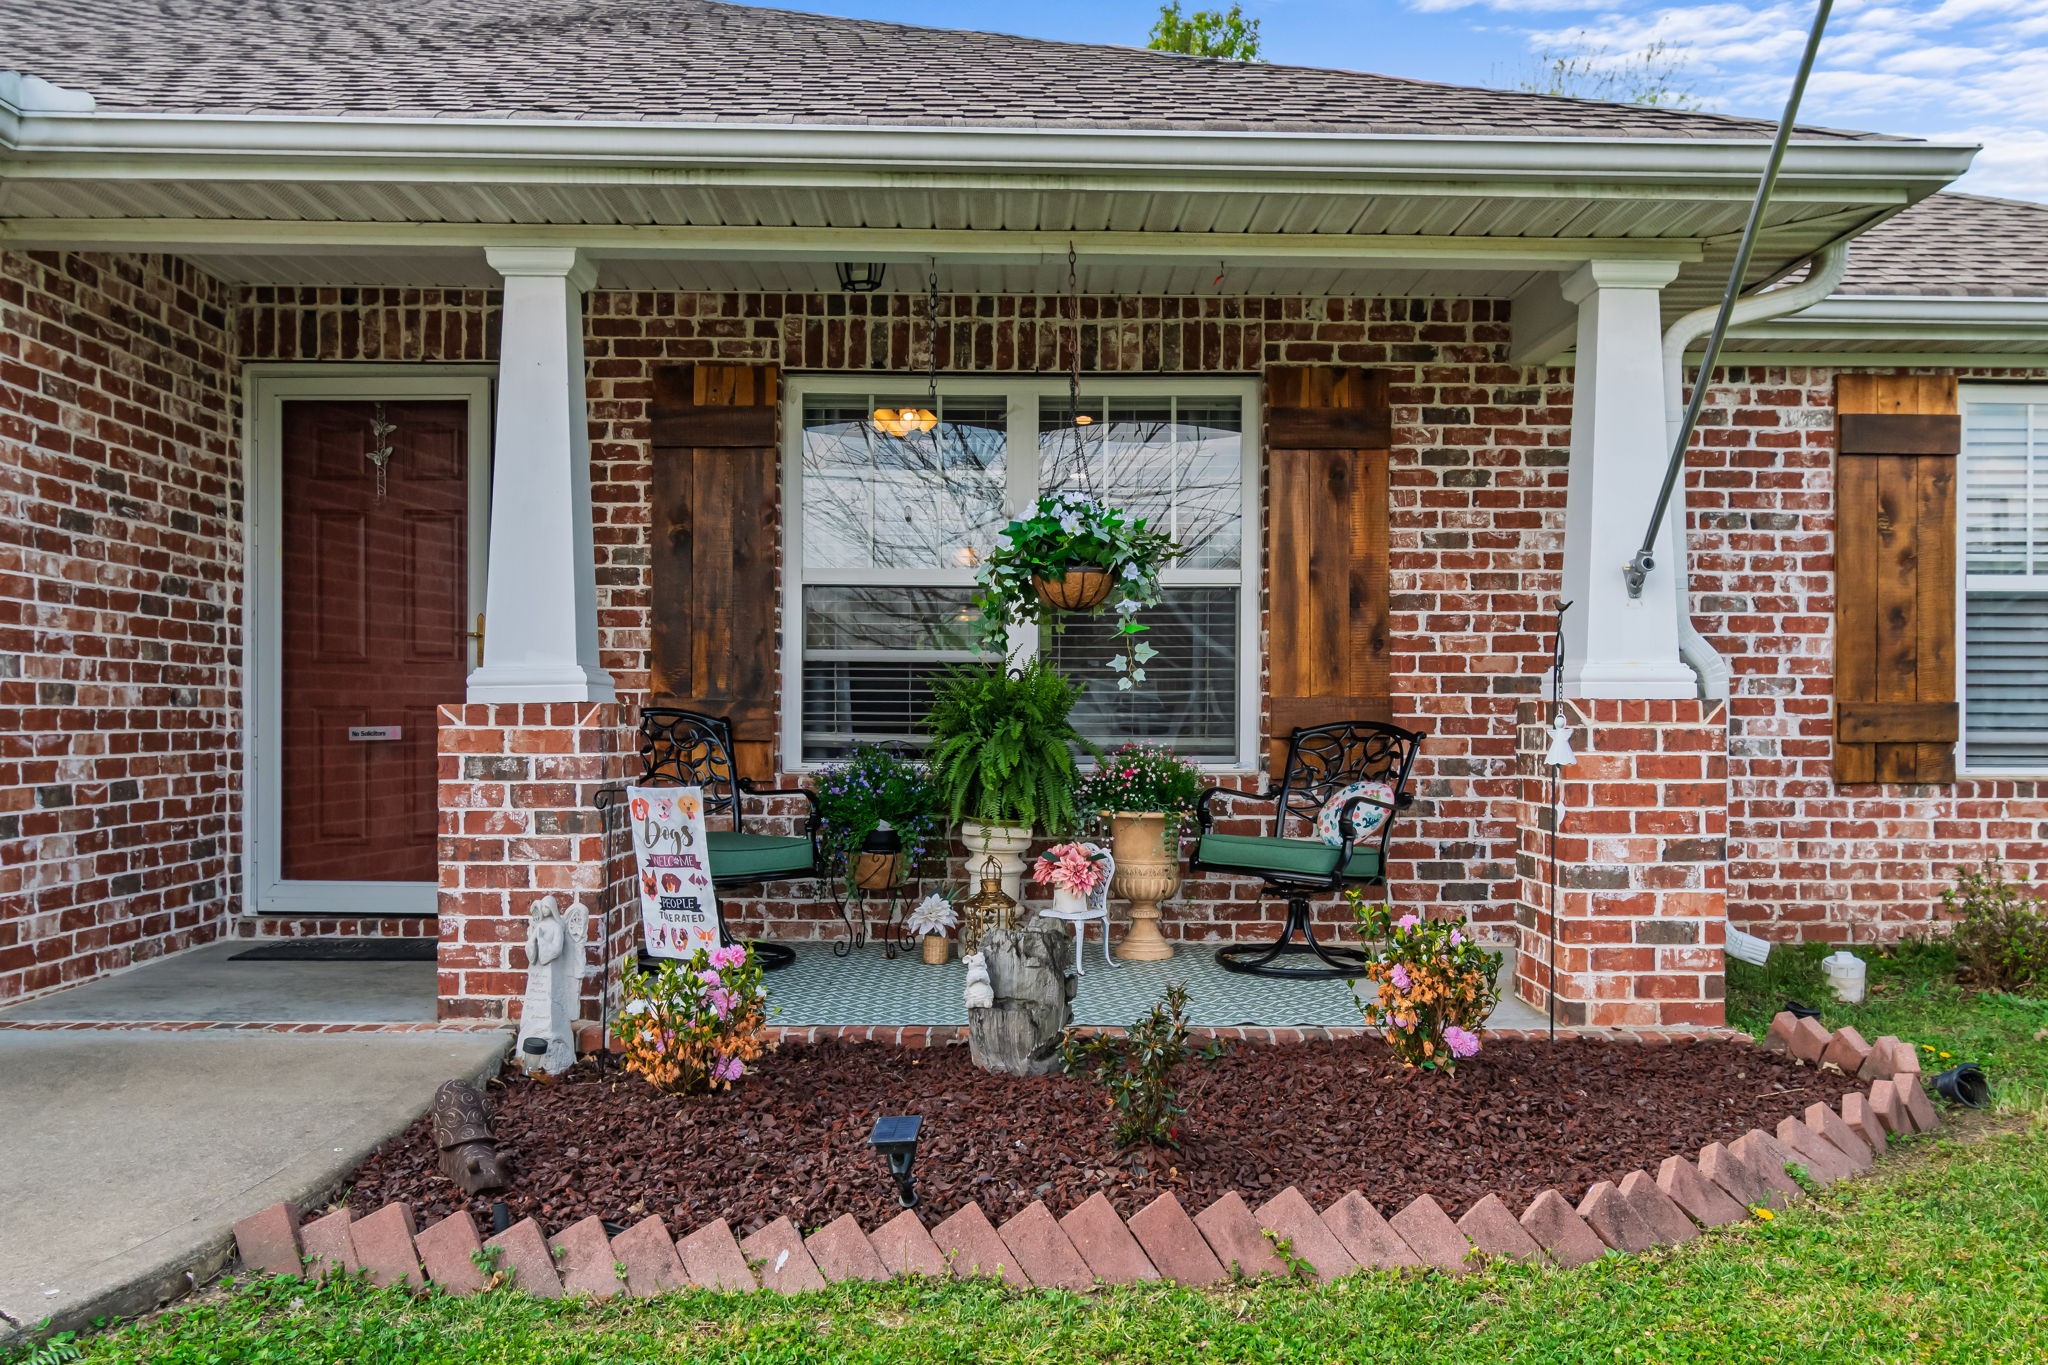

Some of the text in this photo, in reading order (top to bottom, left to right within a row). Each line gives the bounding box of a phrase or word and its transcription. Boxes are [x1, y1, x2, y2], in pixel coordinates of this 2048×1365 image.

[644, 816, 694, 856] Dogs
[661, 898, 694, 909] PEOPLE
[659, 911, 705, 923] TOERATED
